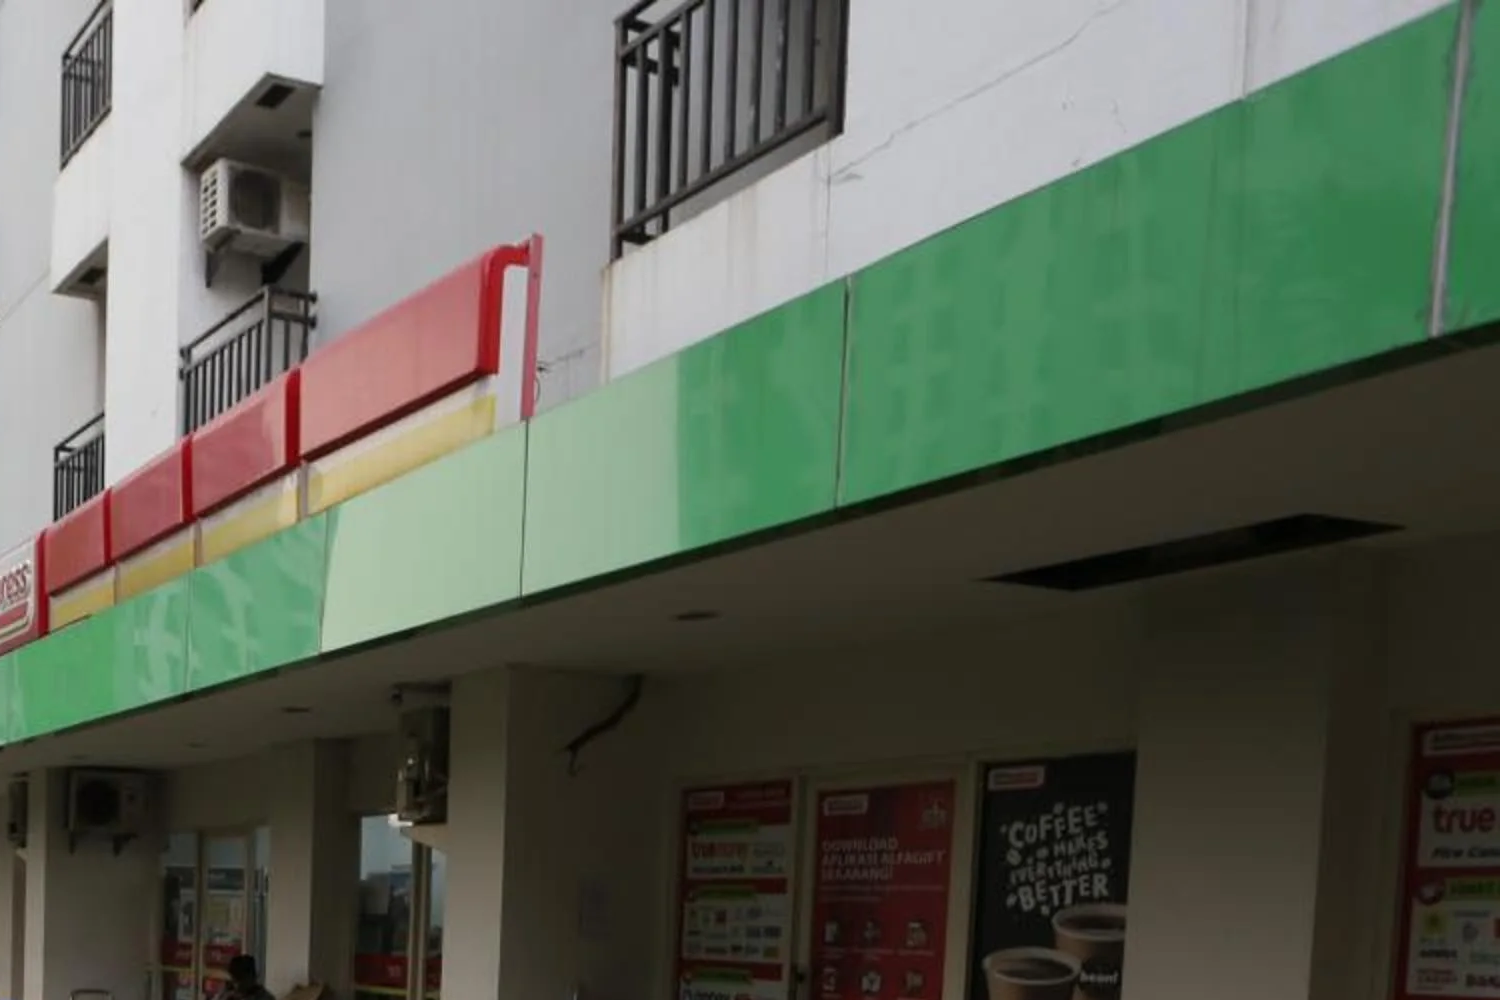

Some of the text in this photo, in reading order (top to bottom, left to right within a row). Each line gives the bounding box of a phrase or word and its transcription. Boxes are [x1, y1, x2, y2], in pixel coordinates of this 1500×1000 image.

[1007, 804, 1098, 849] COFFEE
[1433, 804, 1495, 834] true
[1053, 829, 1109, 859] MAKES
[1010, 847, 1099, 886] EVERYTHING
[1016, 872, 1109, 912] BETTER
